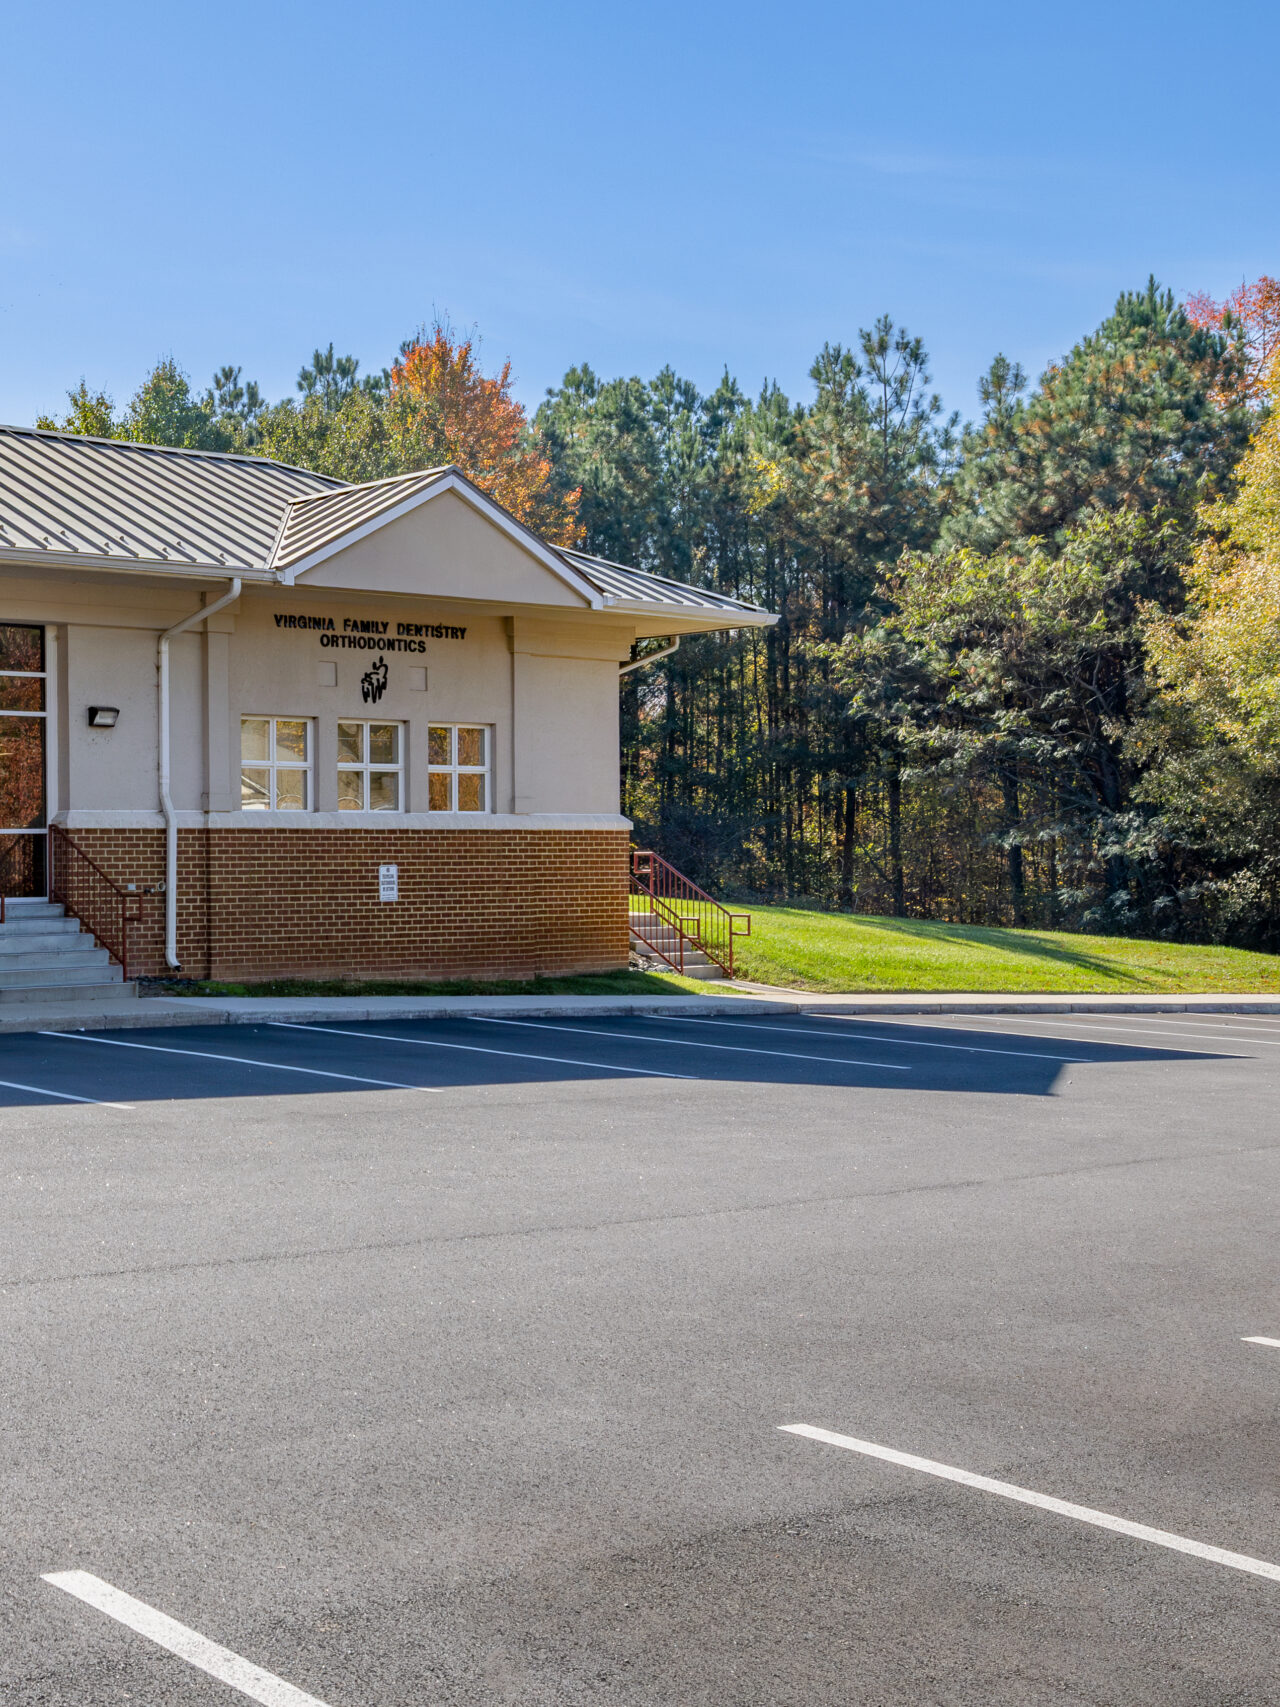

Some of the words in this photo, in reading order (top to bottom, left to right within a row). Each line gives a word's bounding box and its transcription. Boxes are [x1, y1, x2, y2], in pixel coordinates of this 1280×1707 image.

[274, 614, 336, 632] VIRGINIA
[343, 618, 389, 634] FAMILY
[397, 622, 467, 640] DENTISTRY
[320, 633, 426, 653] ORTHODONTICS
